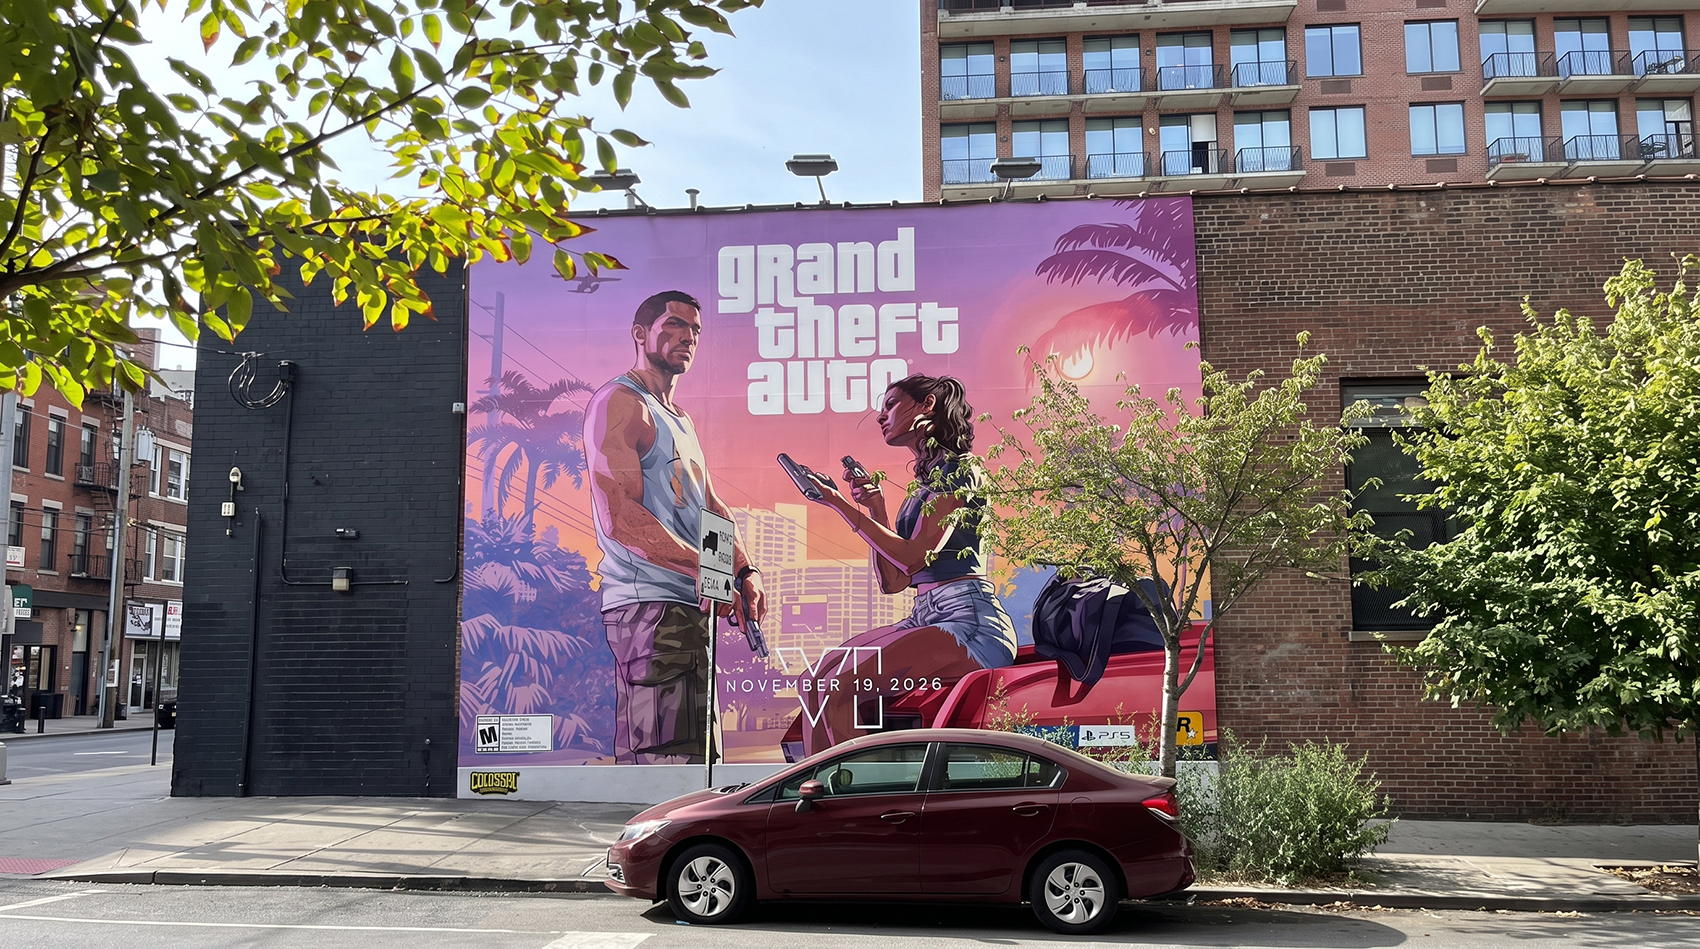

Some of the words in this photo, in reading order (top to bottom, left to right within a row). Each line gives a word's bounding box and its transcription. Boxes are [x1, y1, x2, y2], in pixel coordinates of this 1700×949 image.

[754, 299, 960, 359] theft
[726, 679, 840, 693] NOVEMBER
[853, 678, 881, 693] 19,
[890, 677, 943, 692] 2026
[479, 726, 497, 745] M
[1098, 731, 1131, 740] PS5
